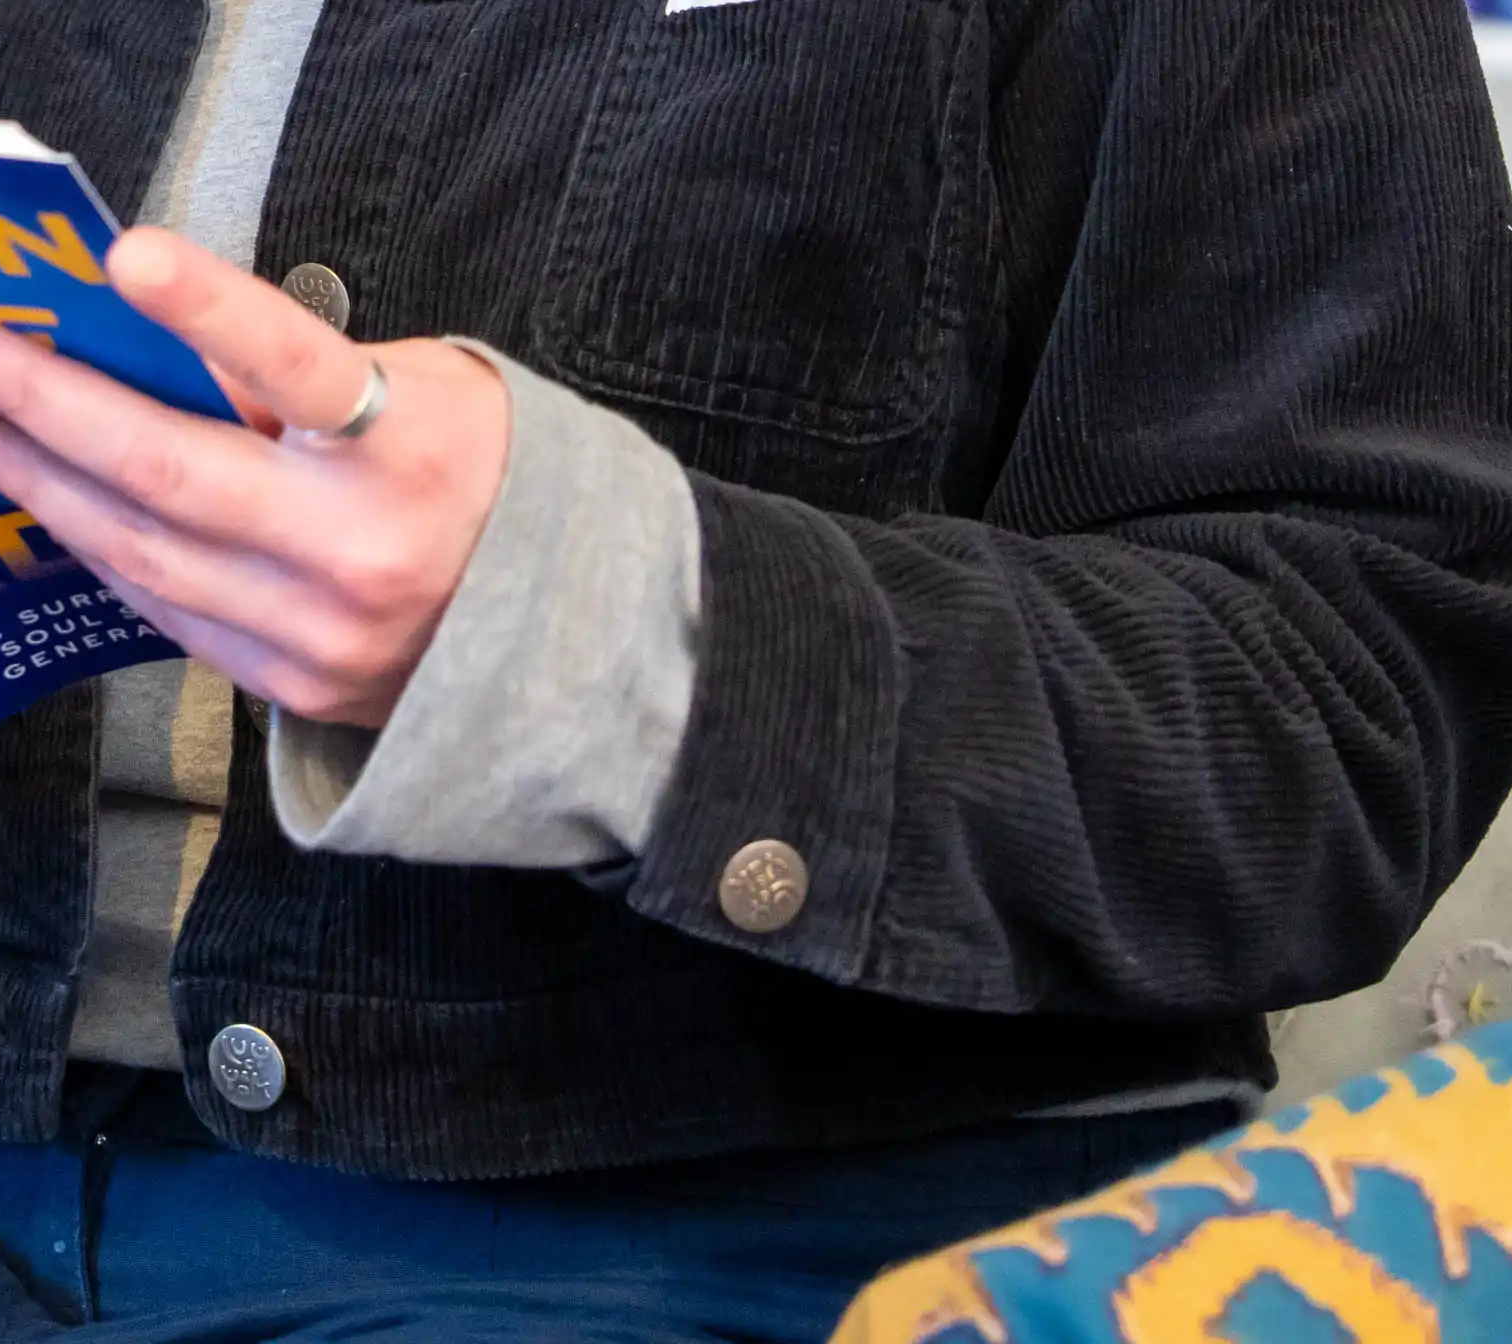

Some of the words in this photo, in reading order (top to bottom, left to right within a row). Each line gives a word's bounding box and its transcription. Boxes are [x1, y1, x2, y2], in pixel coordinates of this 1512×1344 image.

[17, 587, 121, 626] SURR
[0, 613, 103, 658] SOUL
[2, 623, 159, 681] GENERA
